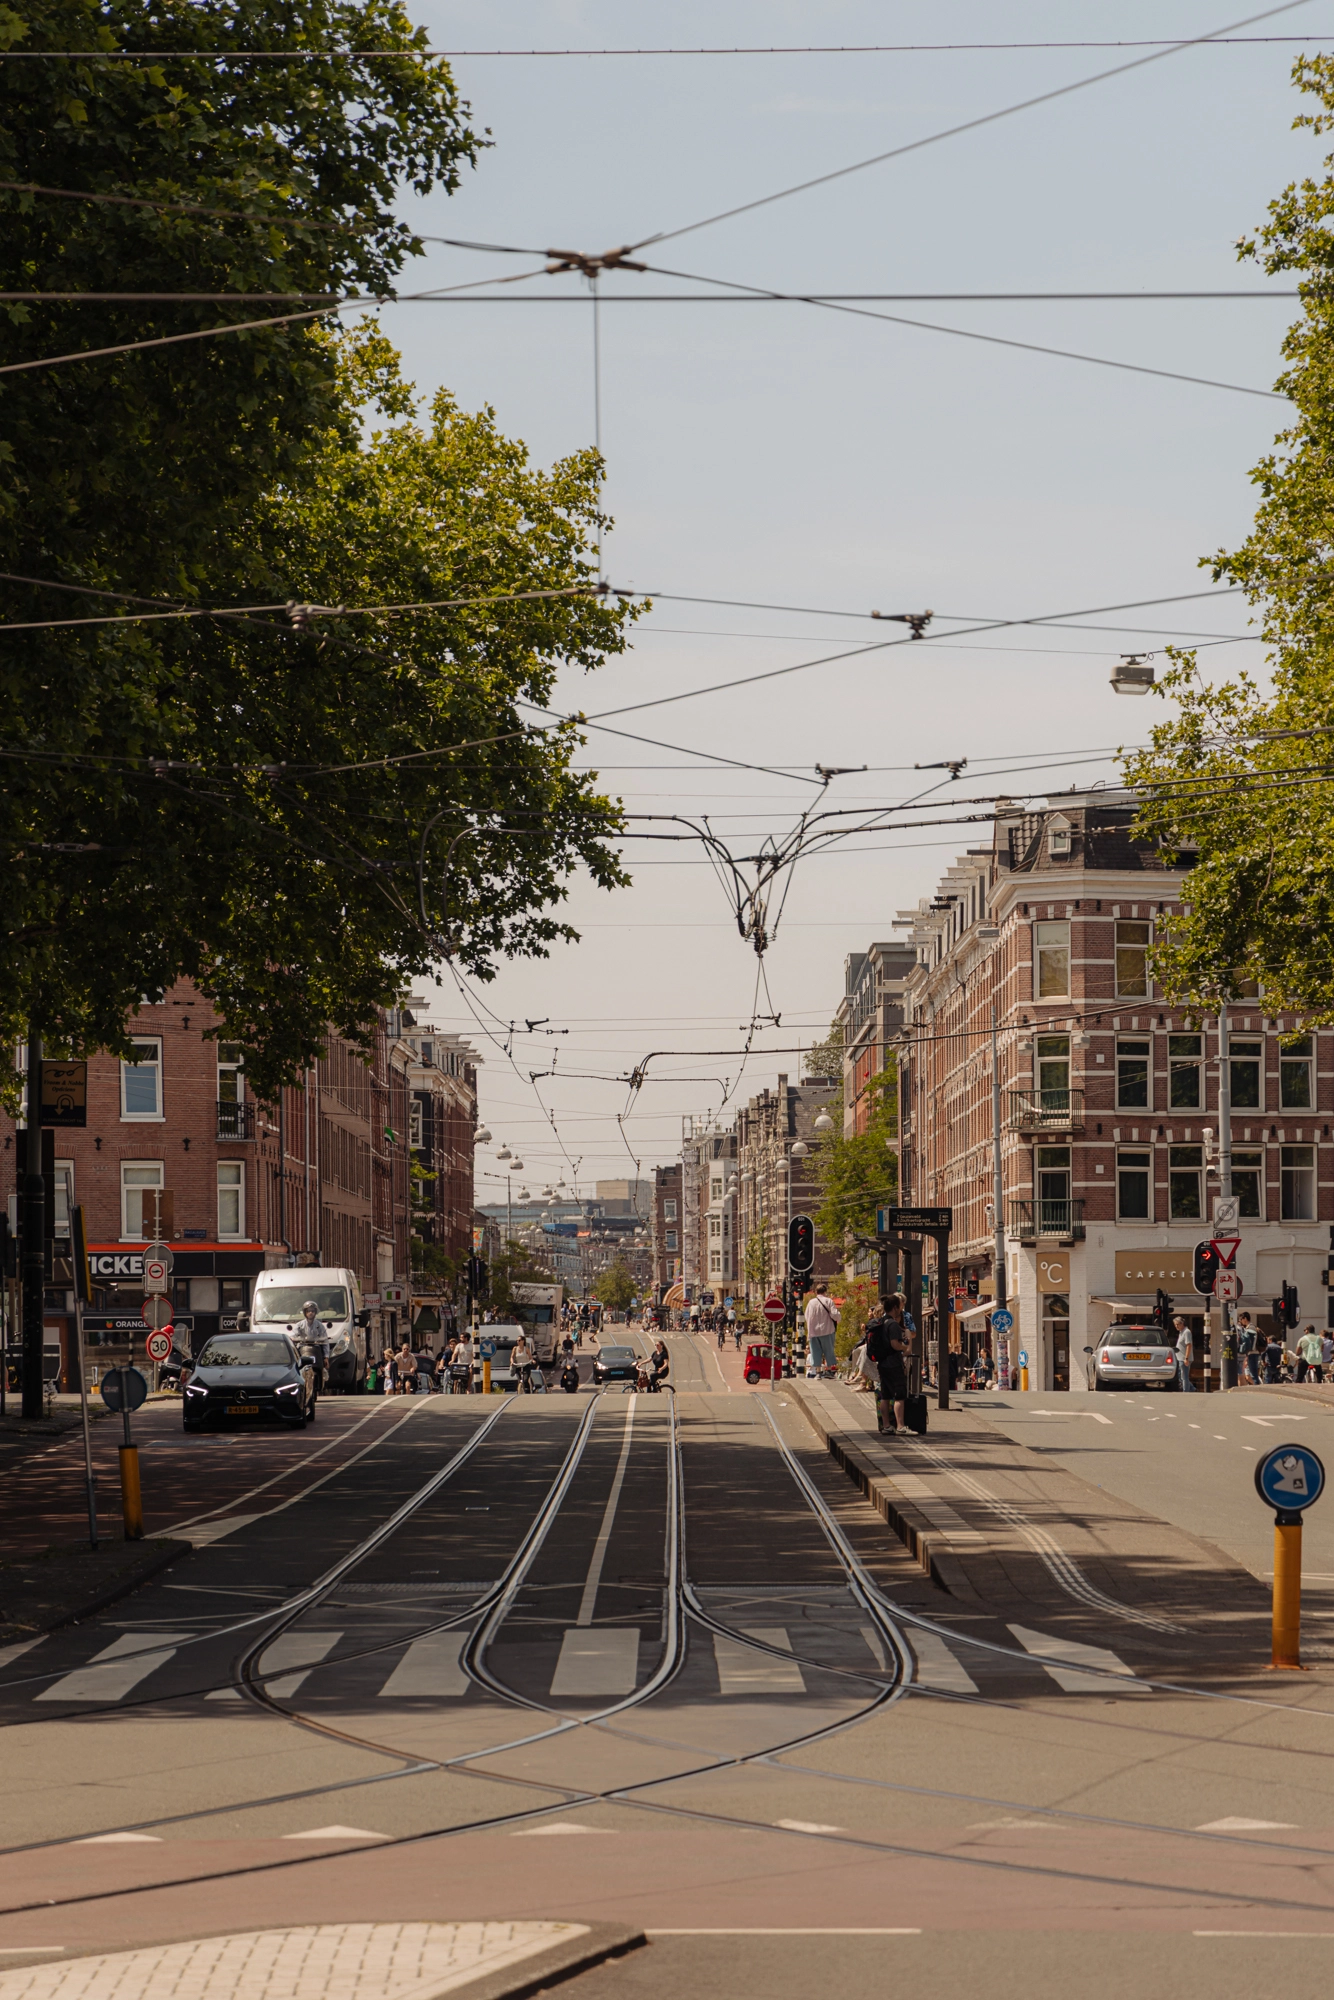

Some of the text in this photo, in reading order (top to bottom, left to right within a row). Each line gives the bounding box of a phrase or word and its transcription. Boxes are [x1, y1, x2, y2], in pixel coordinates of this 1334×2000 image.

[88, 1256, 143, 1274] ICKE
[1041, 1261, 1063, 1284] °C
[152, 1340, 168, 1353] 30
